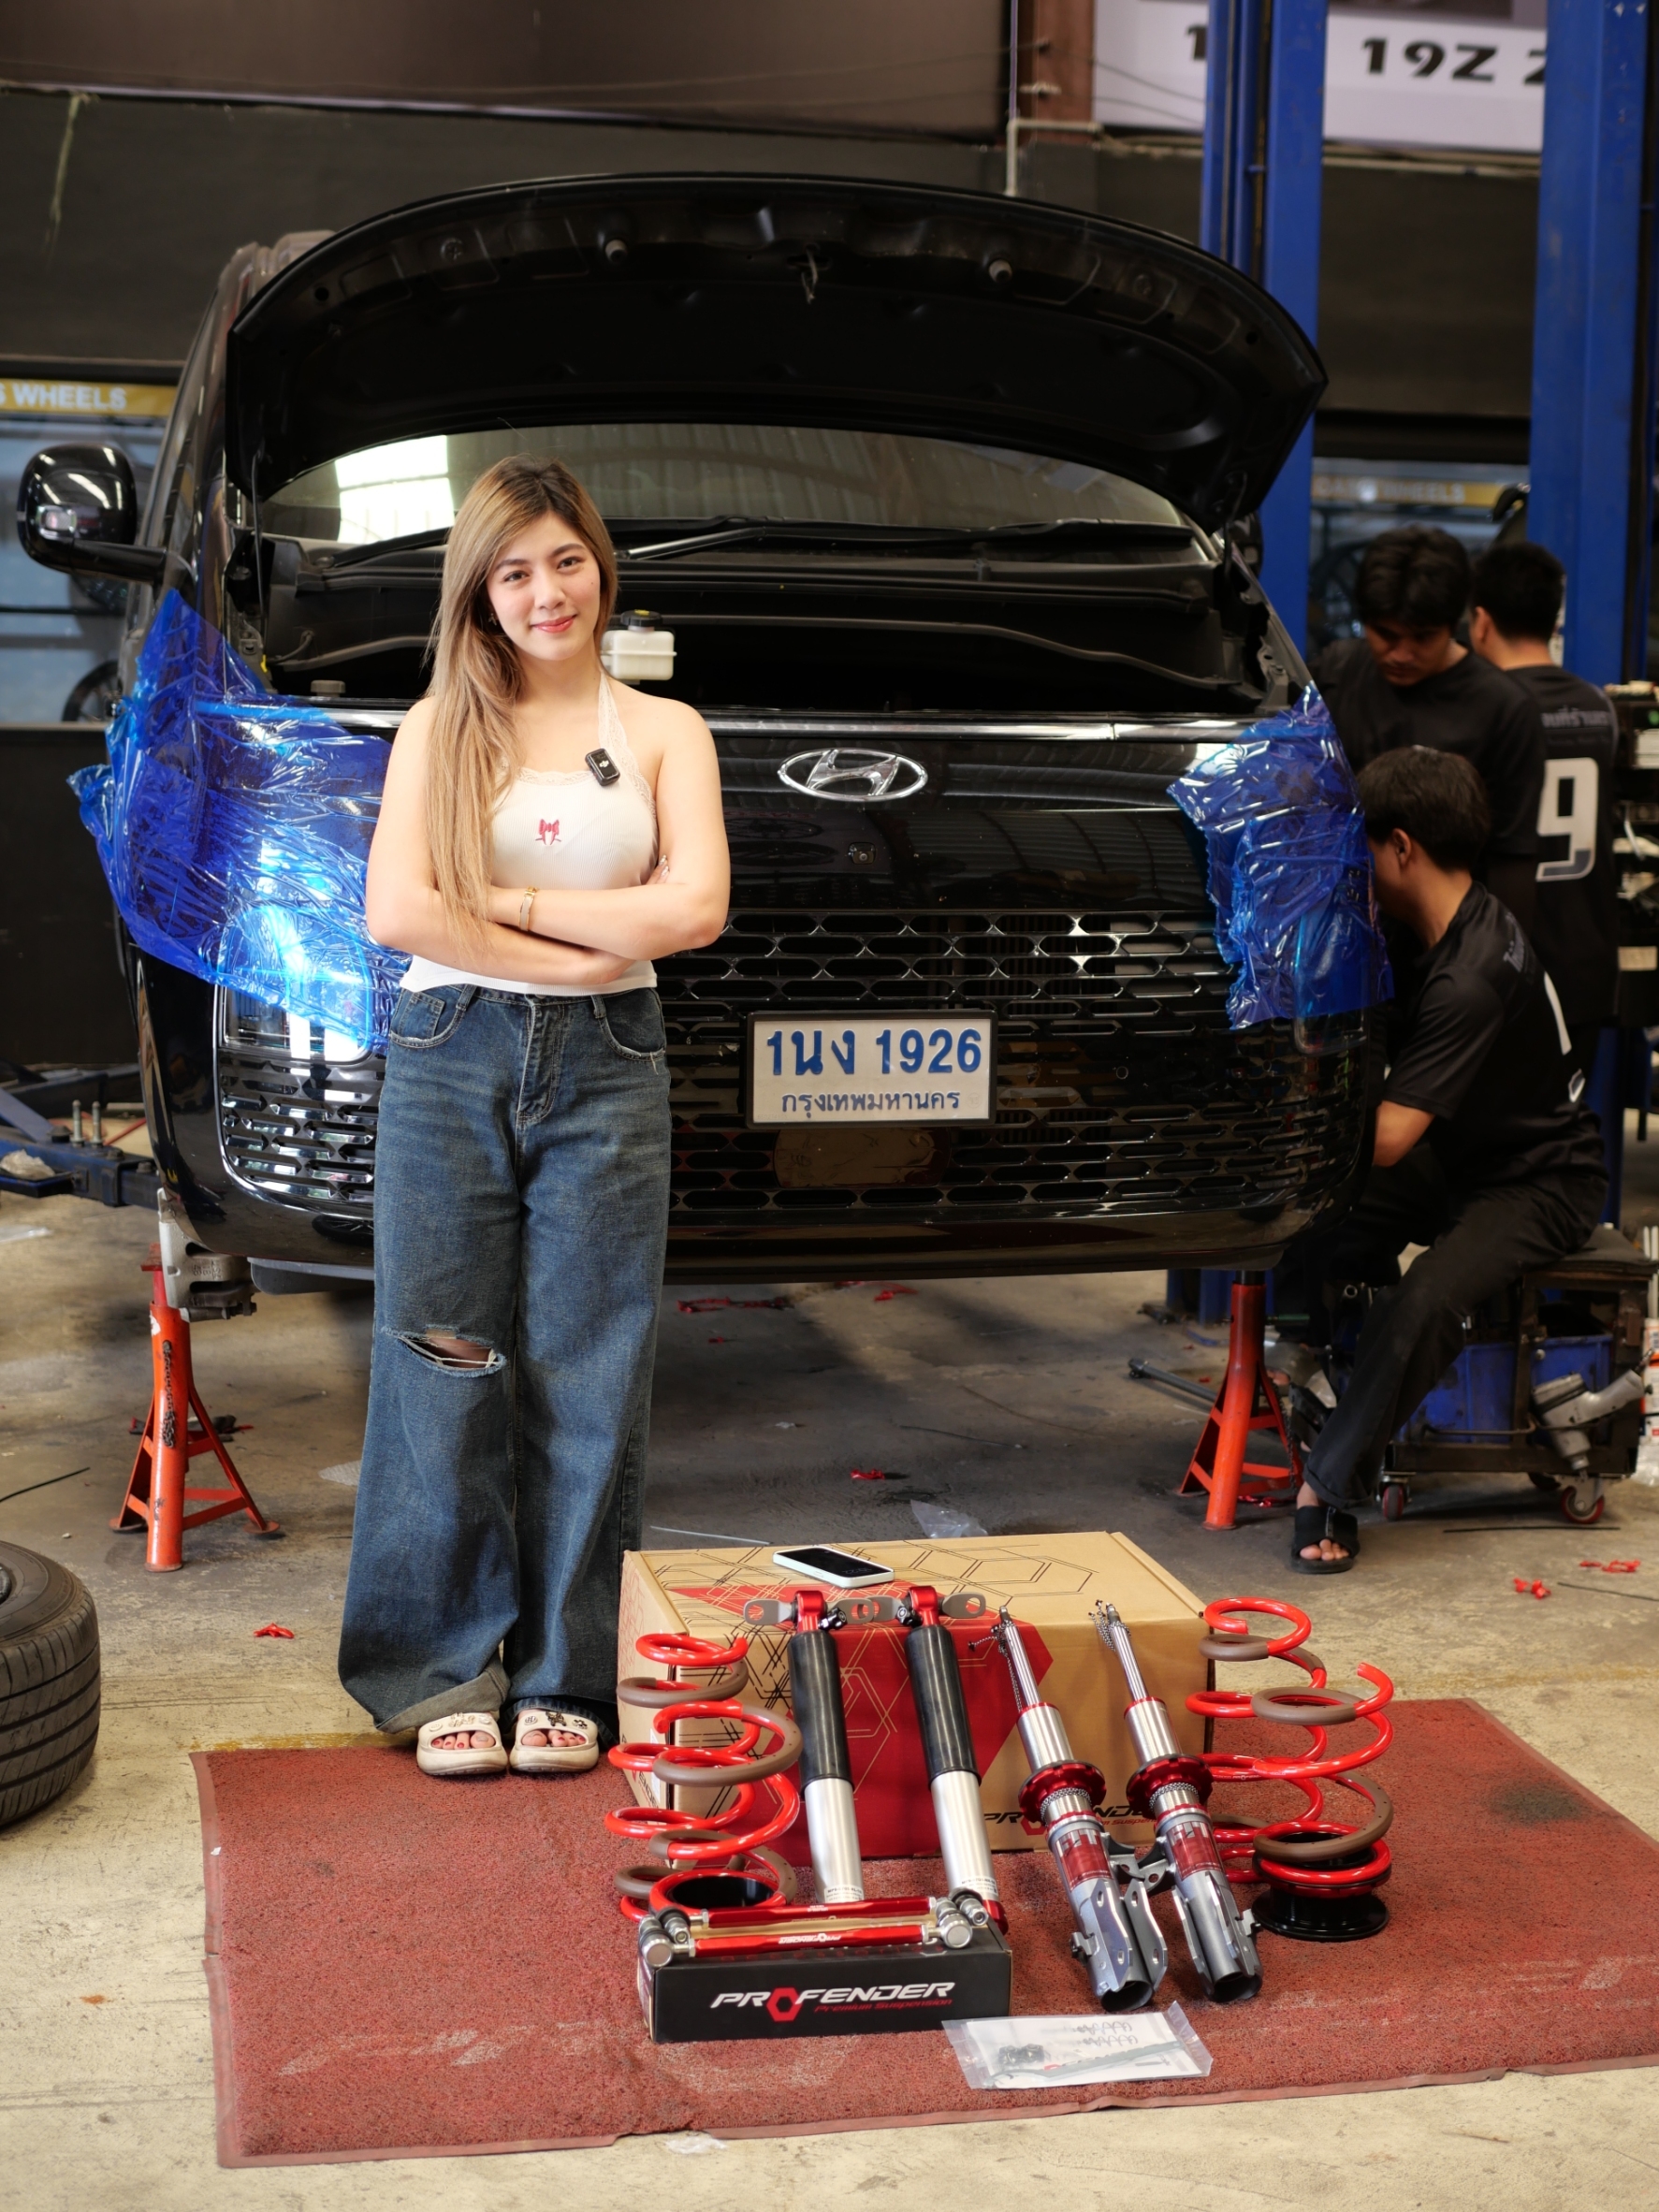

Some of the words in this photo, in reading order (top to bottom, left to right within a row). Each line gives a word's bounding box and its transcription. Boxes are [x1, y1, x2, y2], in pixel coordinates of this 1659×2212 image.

[1362, 36, 1497, 82] 19Z
[12, 382, 127, 410] WHEELS
[1536, 757, 1599, 882] 9
[766, 1029, 855, 1075] 1นง
[876, 1027, 982, 1074] 1926
[781, 1091, 960, 1118] กรุงเทพมหานคร
[710, 1982, 955, 2022] PROFENDER
[814, 2002, 872, 2012] Premium
[874, 1998, 953, 2011] Suspension
